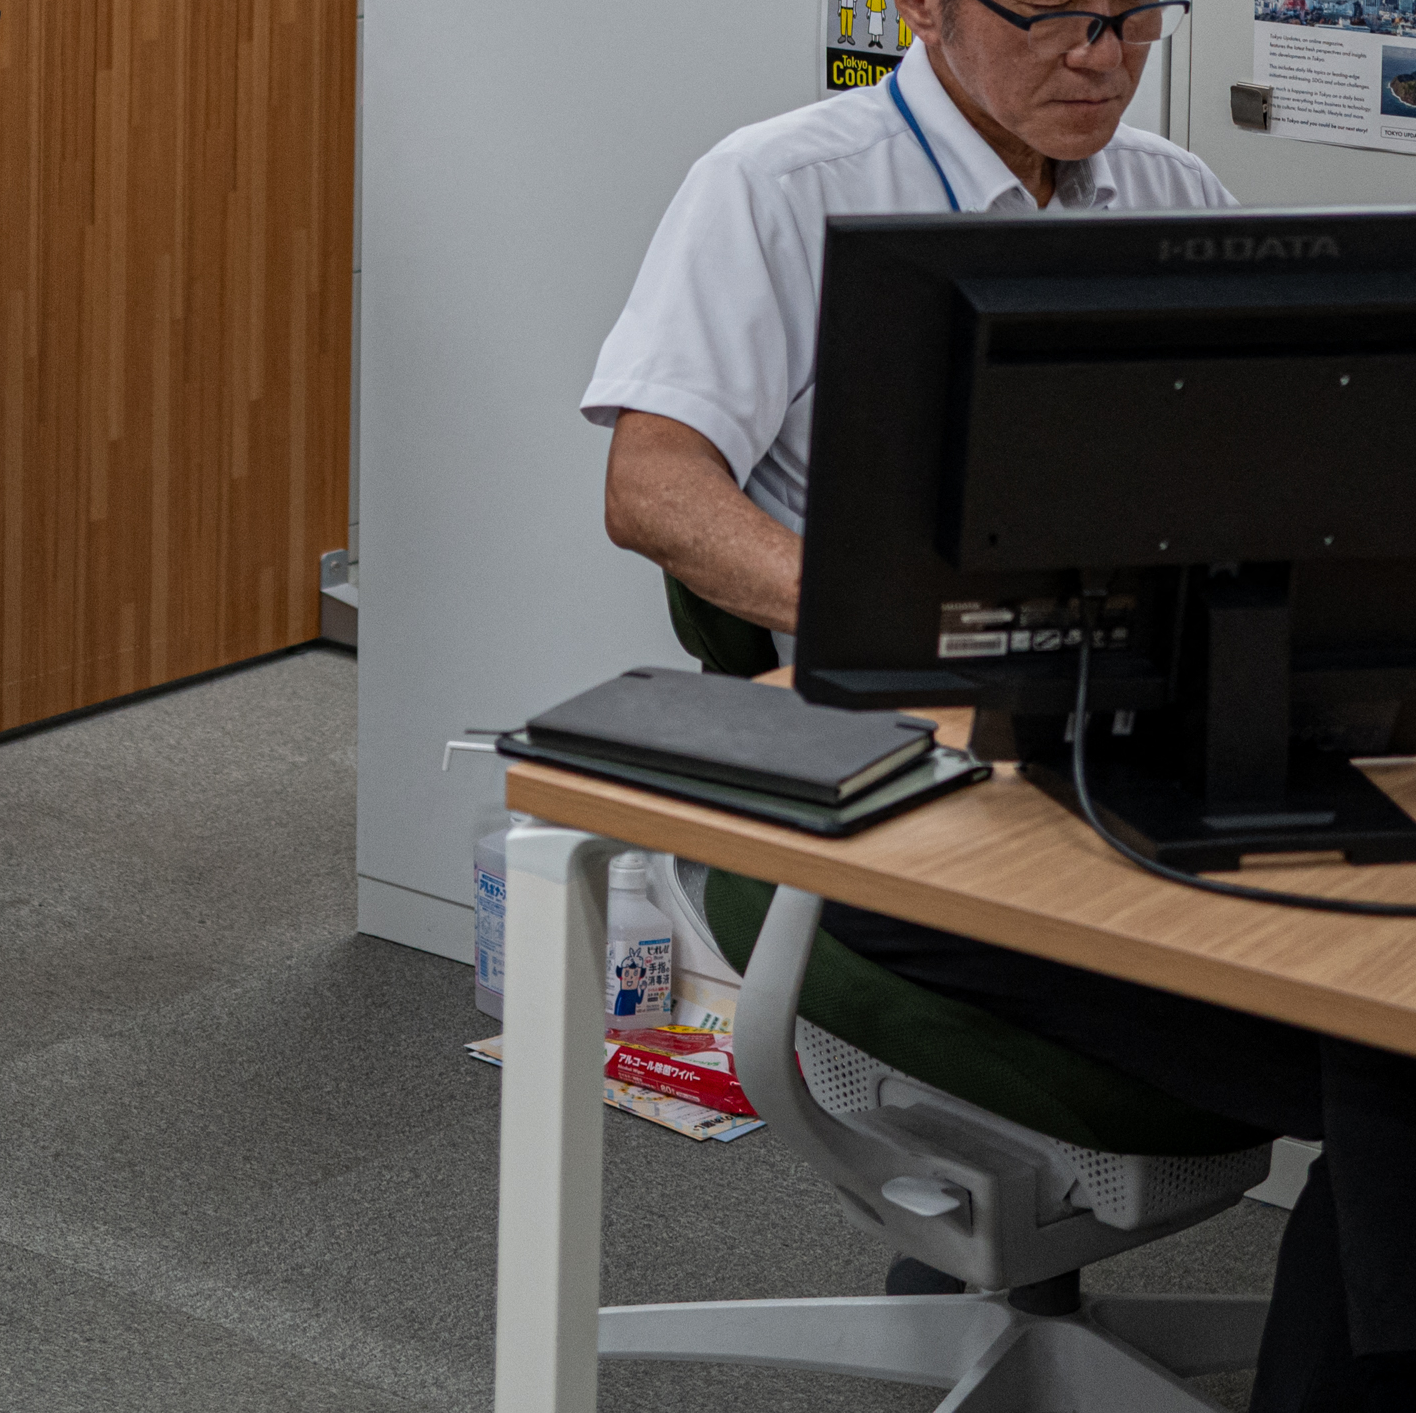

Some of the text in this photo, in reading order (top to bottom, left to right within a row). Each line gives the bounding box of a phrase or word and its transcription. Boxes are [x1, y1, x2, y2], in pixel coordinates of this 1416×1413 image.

[842, 55, 867, 70] Tokyo
[1278, 52, 1306, 60] developments
[833, 61, 873, 86] Cool
[1289, 75, 1311, 83] addressing
[1291, 88, 1313, 96] happening
[1343, 93, 1353, 101] daily
[1292, 97, 1313, 105] everything
[1224, 237, 1339, 261] DATA
[619, 1053, 700, 1081] アルコール除菌ワイパー
